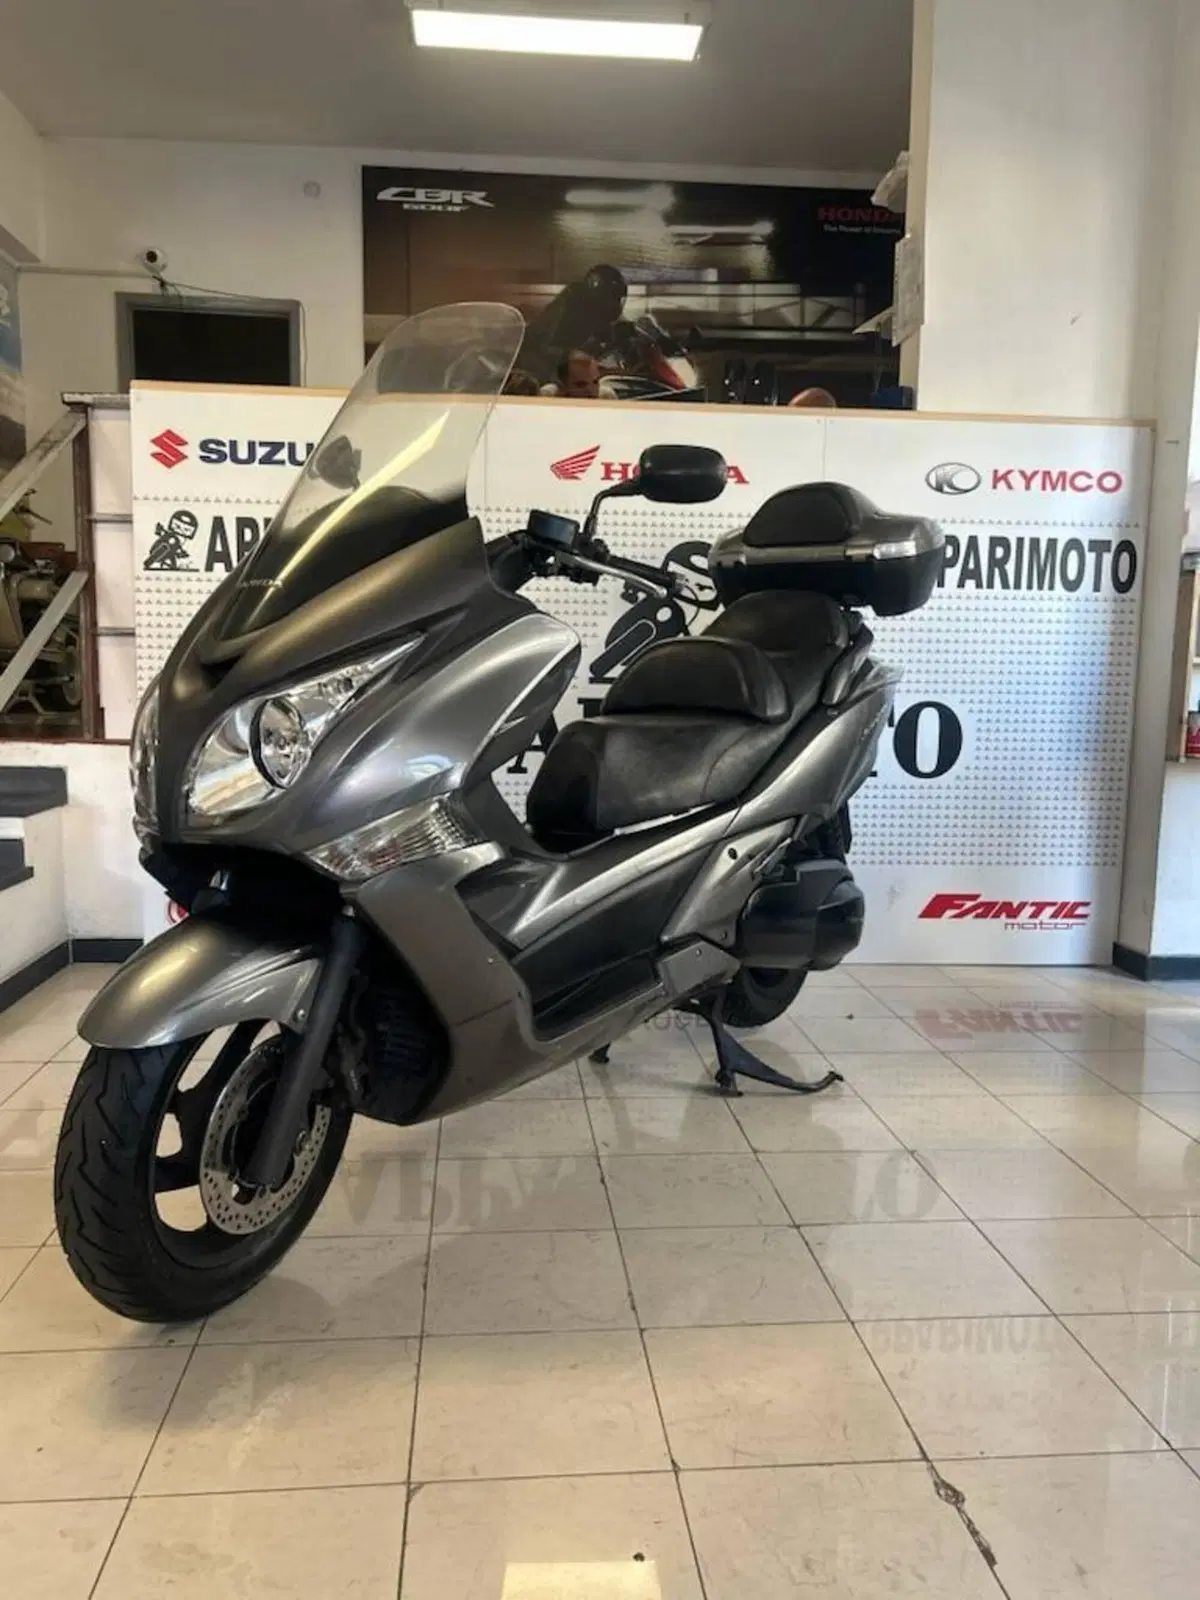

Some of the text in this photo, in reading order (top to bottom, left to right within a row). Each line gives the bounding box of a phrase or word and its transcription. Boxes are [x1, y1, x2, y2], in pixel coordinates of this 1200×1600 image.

[198, 437, 317, 467] SUZU
[991, 468, 1123, 493] KYMCO
[936, 534, 1138, 594] PARIMOTO
[917, 893, 1091, 919] FANTIC
[1004, 920, 1087, 931] motor
